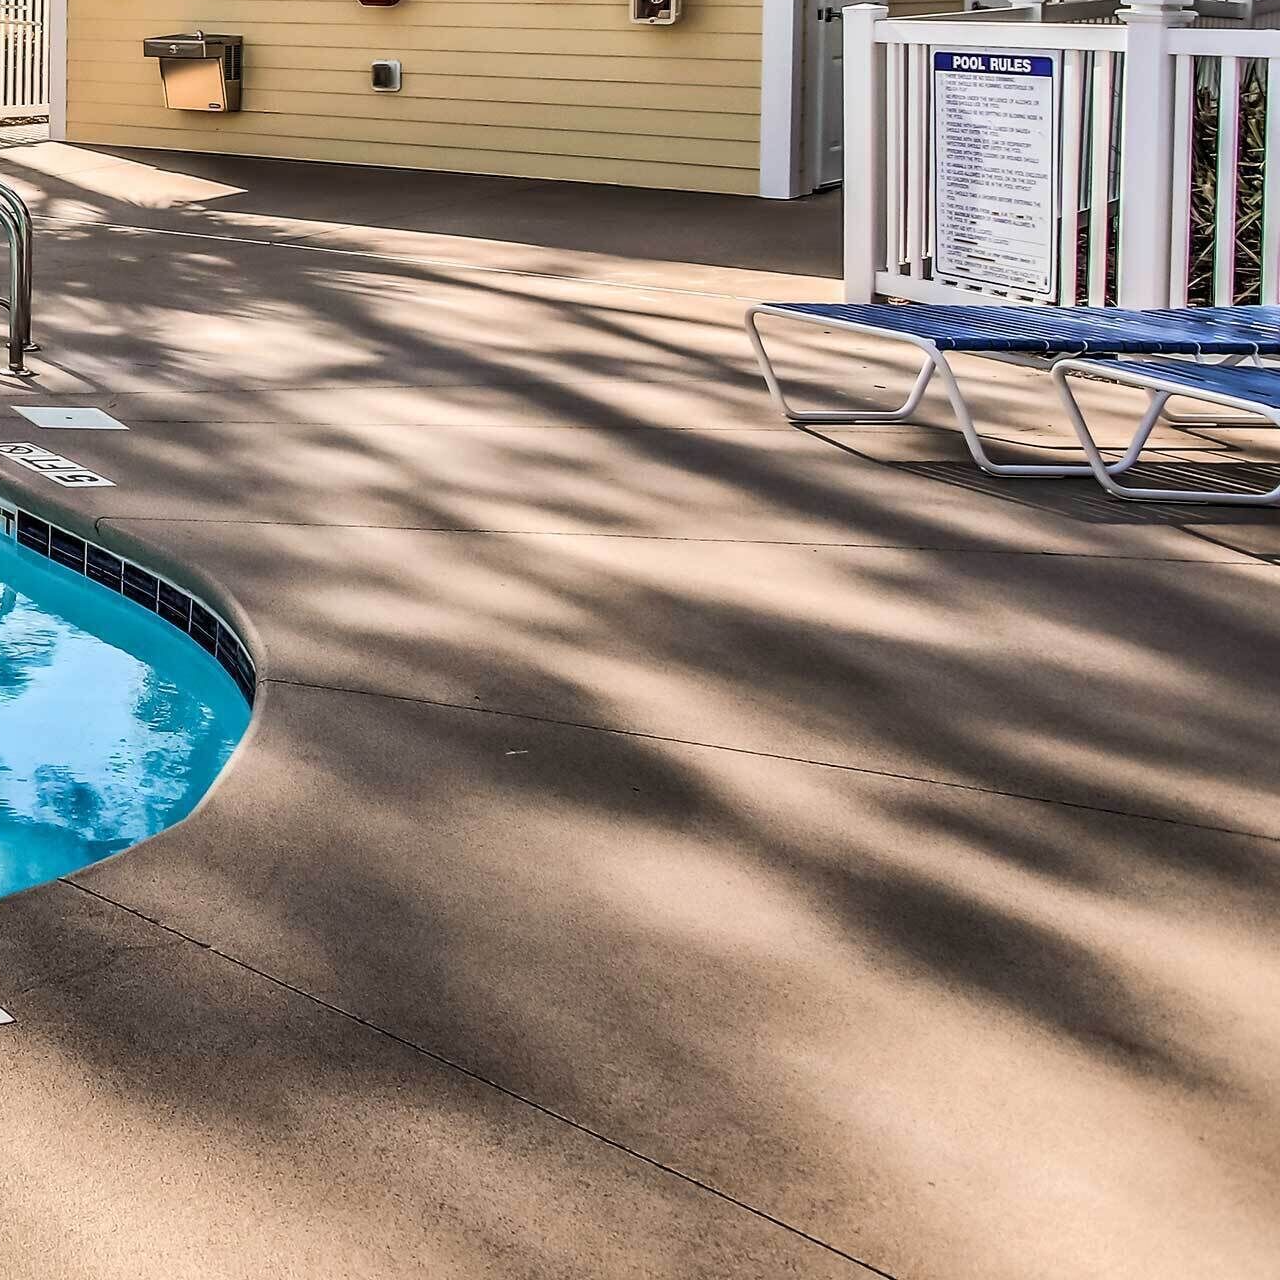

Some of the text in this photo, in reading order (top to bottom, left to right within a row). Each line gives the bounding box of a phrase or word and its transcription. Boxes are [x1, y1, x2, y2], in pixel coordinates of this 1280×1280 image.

[952, 55, 1032, 73] POOL RULES
[19, 457, 99, 483] 5 FT
